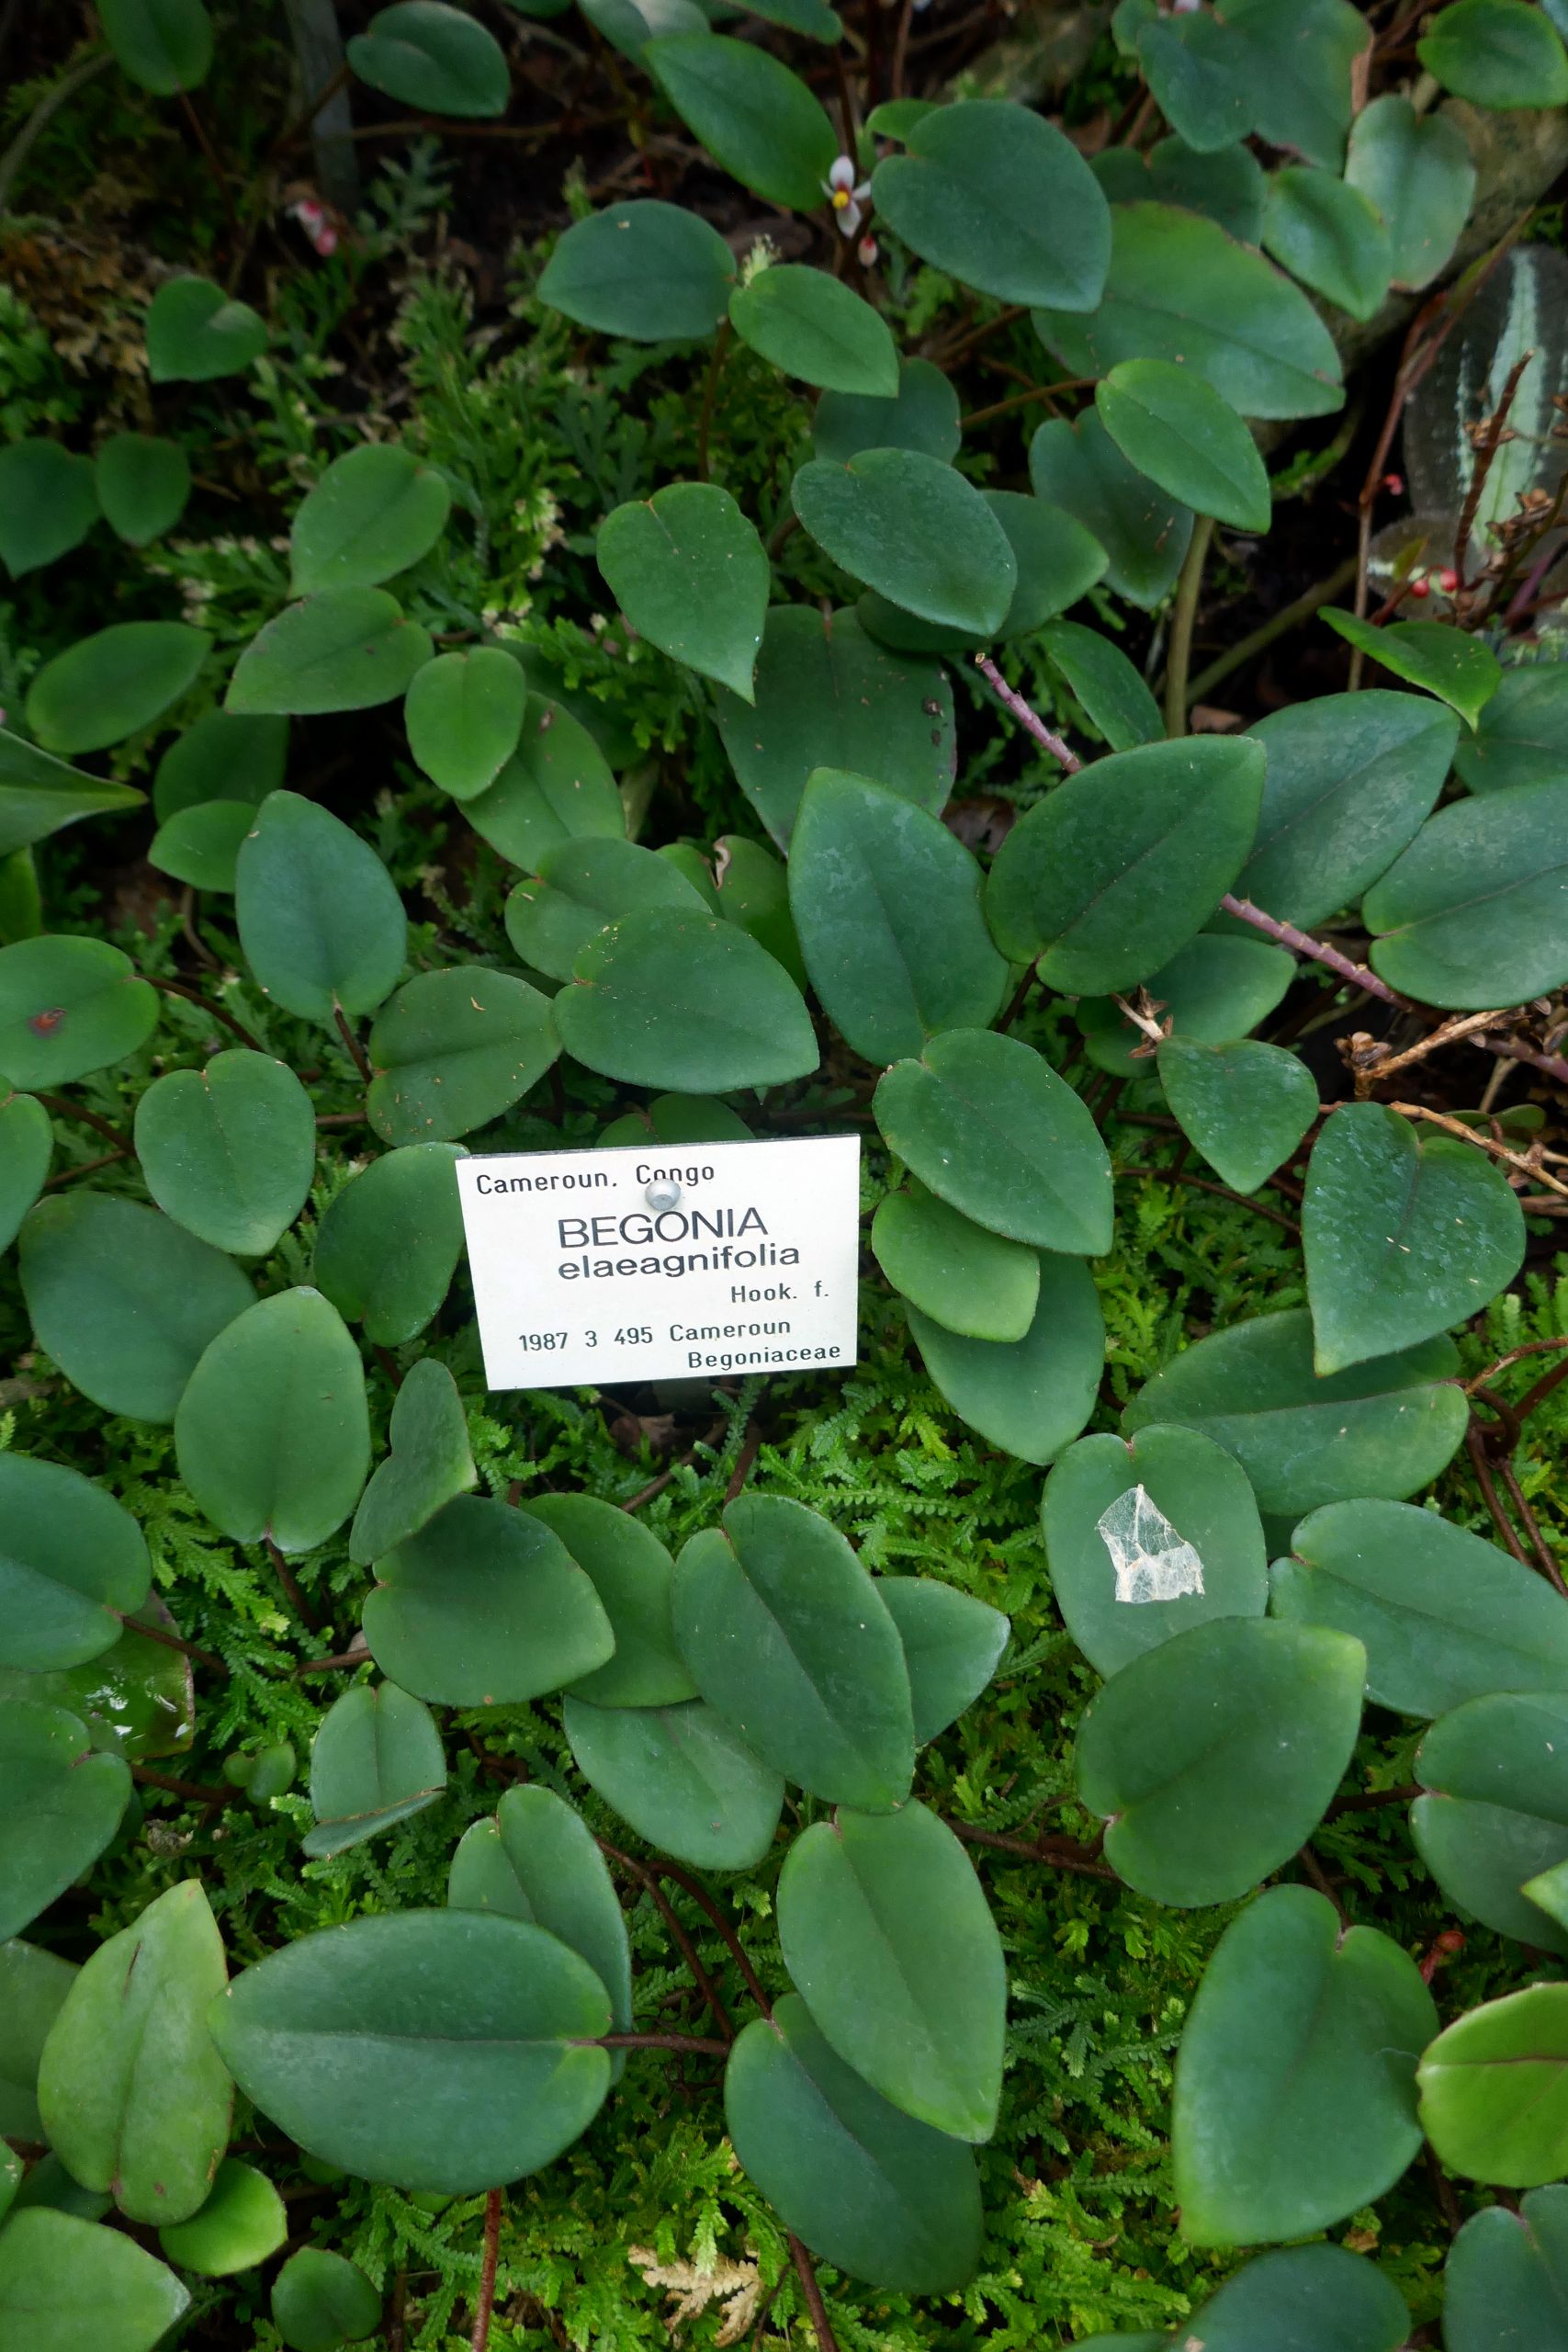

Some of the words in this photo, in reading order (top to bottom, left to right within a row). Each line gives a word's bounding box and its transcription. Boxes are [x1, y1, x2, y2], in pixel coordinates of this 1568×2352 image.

[476, 1172, 617, 1195] Cameroun.
[636, 1164, 715, 1187] Congo
[558, 1206, 769, 1250] BEGONIA
[558, 1242, 800, 1280] elaeagnifolia
[731, 1283, 797, 1303] Hook.
[814, 1280, 829, 1297] f.
[519, 1332, 569, 1351] 1987
[585, 1330, 598, 1348] 3
[614, 1326, 653, 1345] 495
[670, 1321, 791, 1342] Cameroun
[688, 1345, 841, 1371] Begoniaceae
